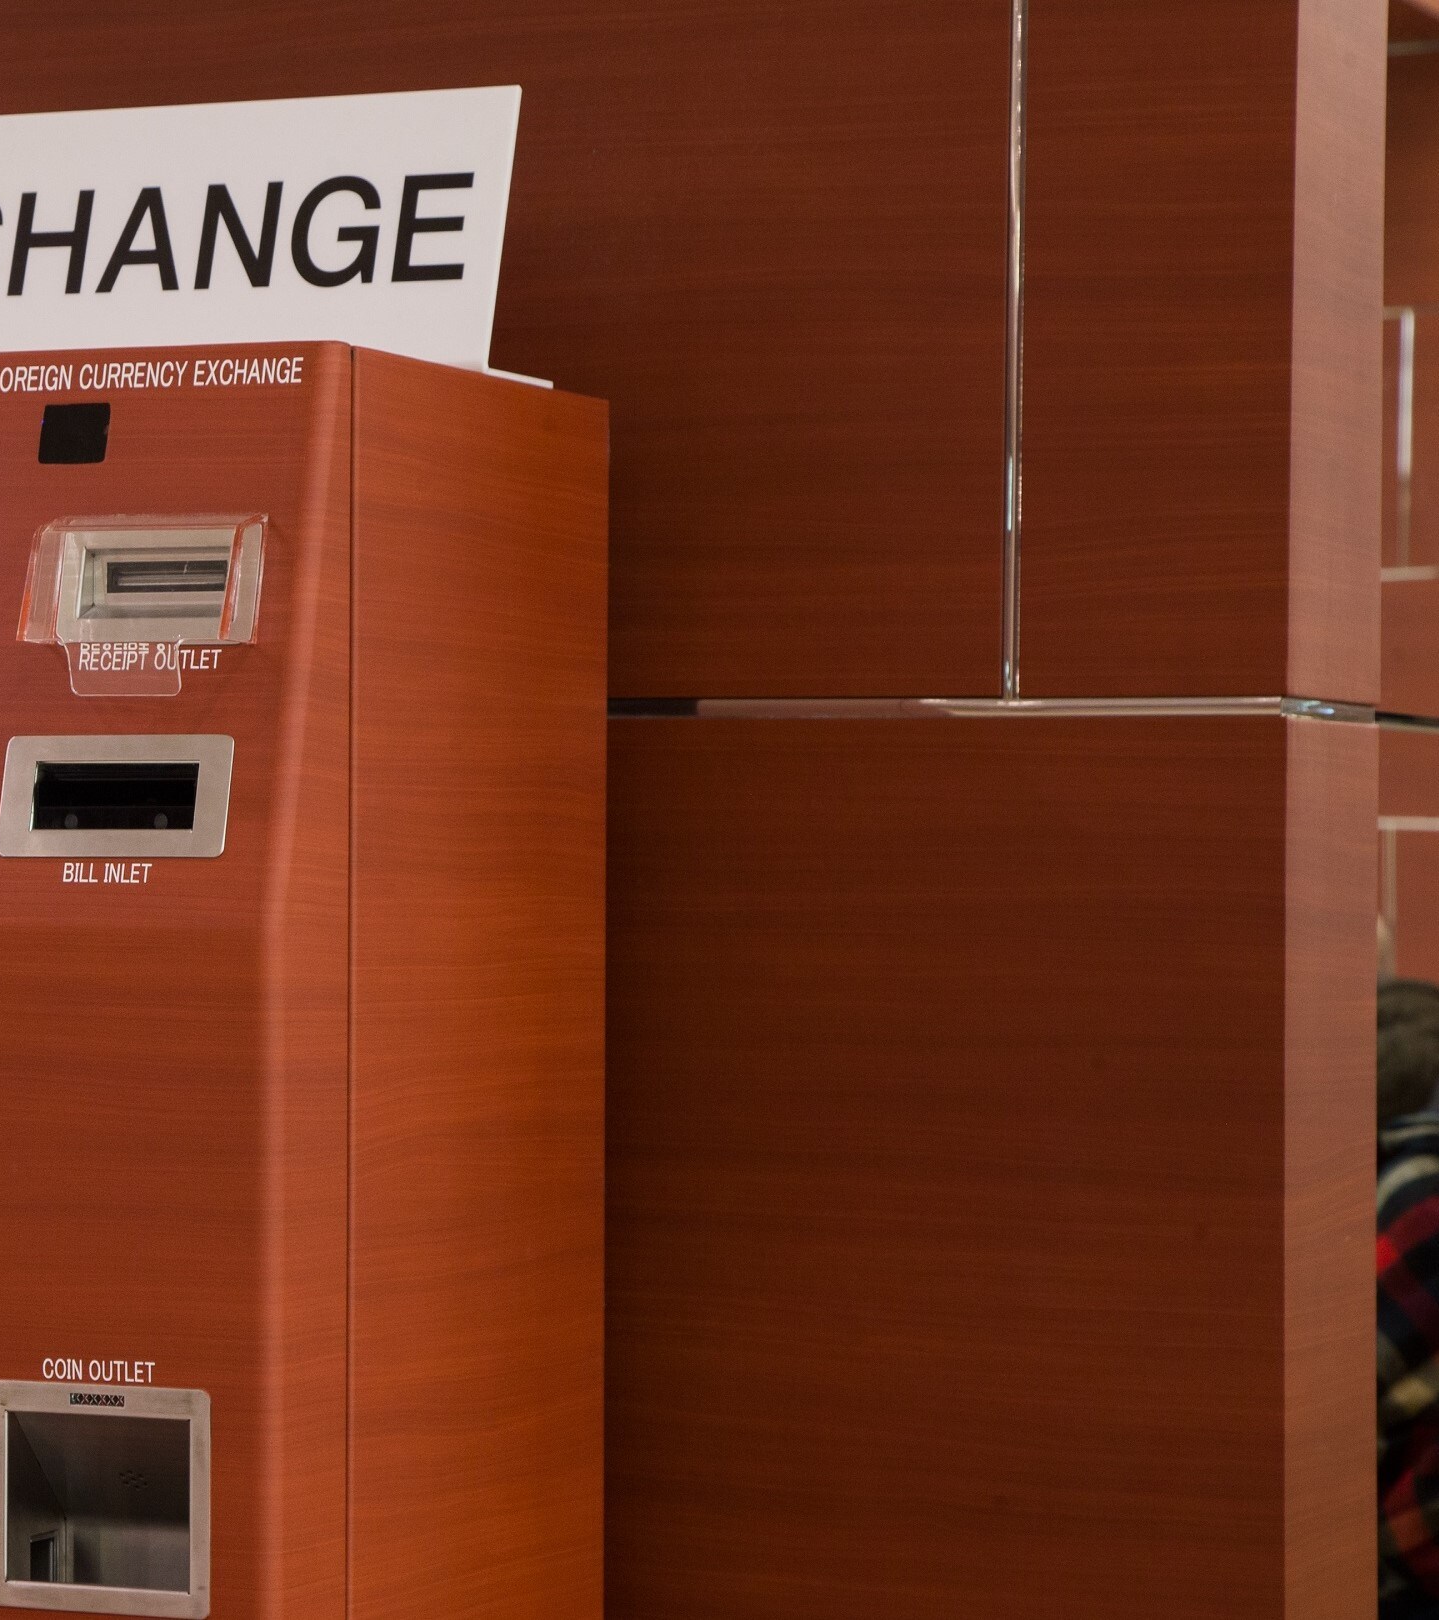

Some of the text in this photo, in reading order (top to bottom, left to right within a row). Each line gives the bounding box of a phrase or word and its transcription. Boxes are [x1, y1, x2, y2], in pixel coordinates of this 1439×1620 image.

[79, 360, 188, 390] CURRENCY
[193, 357, 303, 386] EXCHANGE
[79, 649, 222, 671] RECEIPT OUTLET
[62, 862, 153, 884] BILL INLET
[42, 1358, 155, 1383] COIN OUTLET
